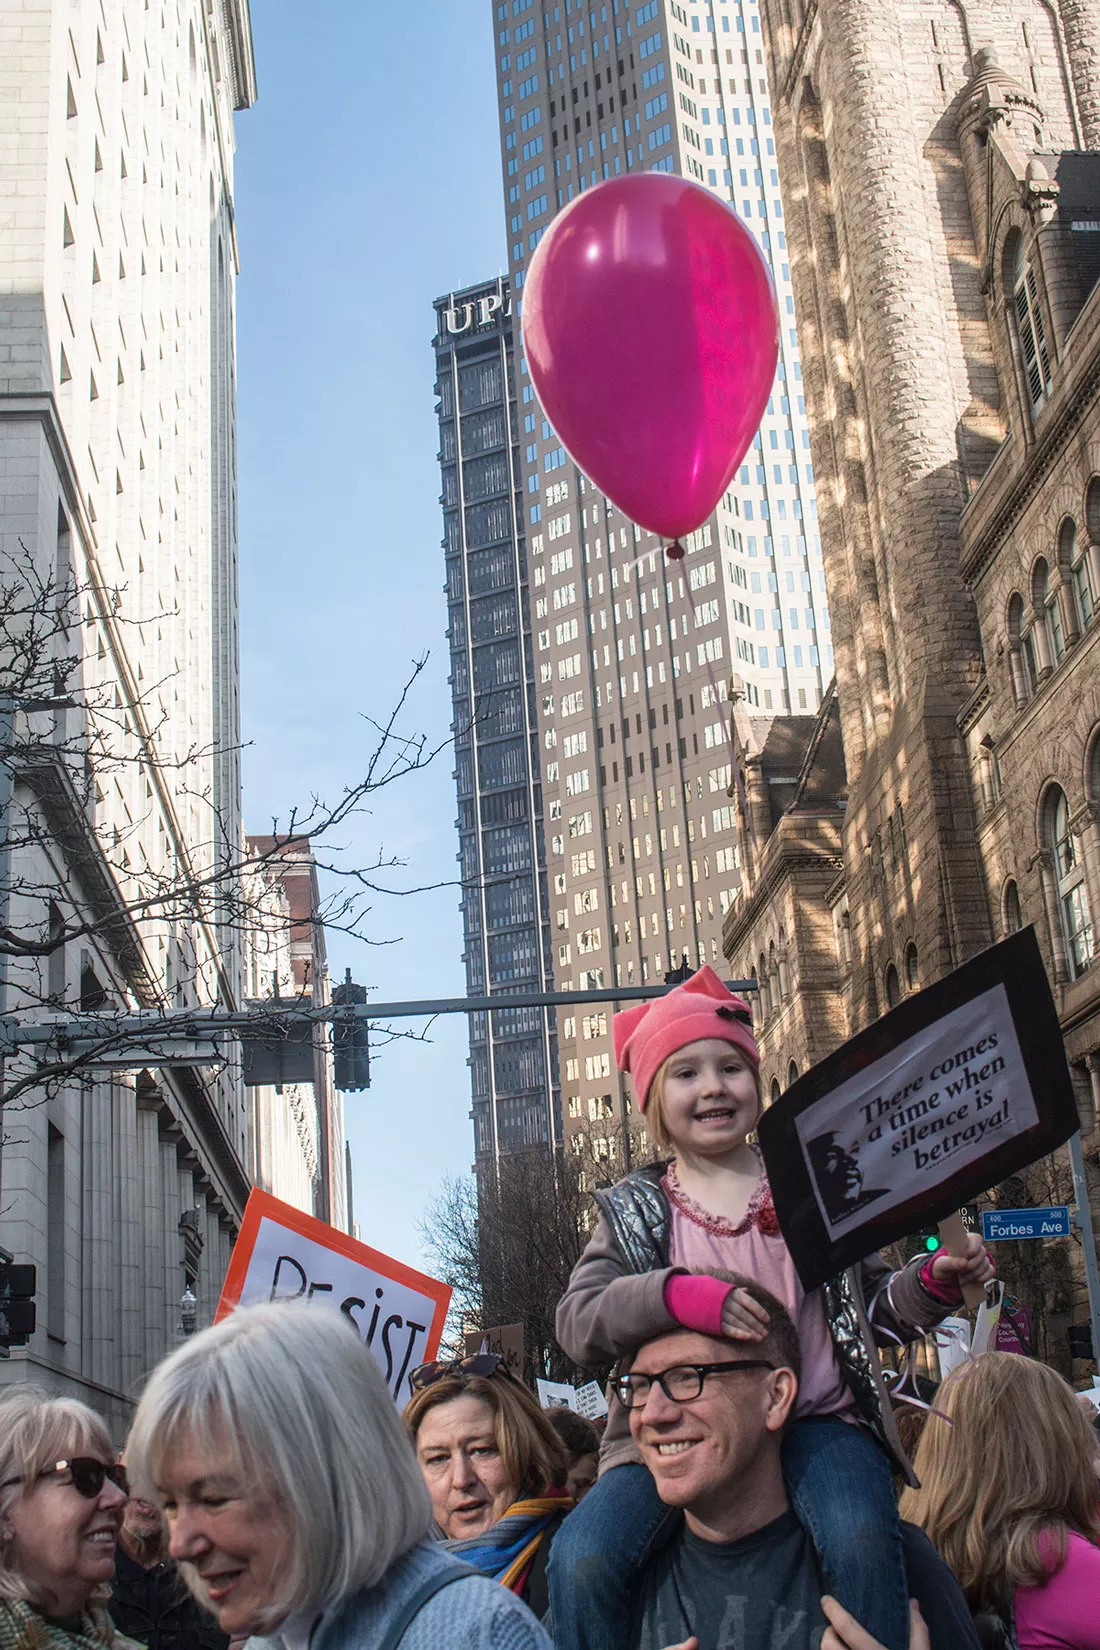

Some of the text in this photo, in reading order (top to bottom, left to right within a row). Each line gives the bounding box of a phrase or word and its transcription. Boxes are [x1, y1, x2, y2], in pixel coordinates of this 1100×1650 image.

[859, 1033, 999, 1125] There comes
[867, 1125, 883, 1142] a
[888, 1091, 941, 1131] time
[945, 1055, 1006, 1099] when
[891, 1104, 969, 1157] silence
[974, 1088, 993, 1111] is
[913, 1099, 1010, 1170] betrayal
[990, 1221, 1063, 1237] Forbes Ave
